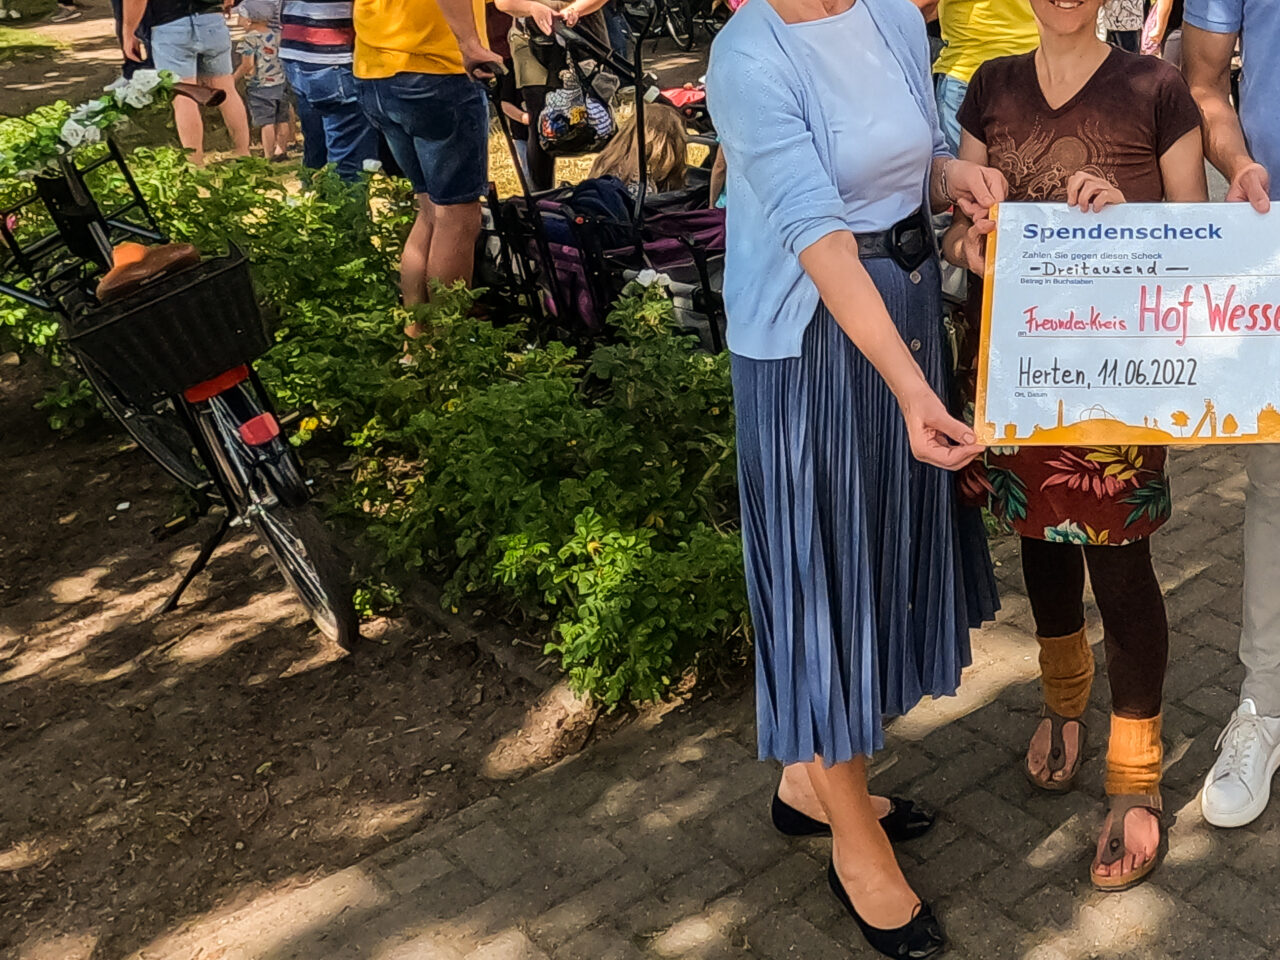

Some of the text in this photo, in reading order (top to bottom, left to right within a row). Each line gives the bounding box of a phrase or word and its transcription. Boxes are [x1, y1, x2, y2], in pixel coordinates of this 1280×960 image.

[1022, 223, 1223, 243] Spendenscheck
[1022, 251, 1163, 261] Zahlen Sie gegen diesen Scheck
[1020, 277, 1094, 286] Betrag in Buchstaben
[1138, 285, 1194, 347] Hof
[1018, 356, 1199, 390] Herten, 11.06.2022
